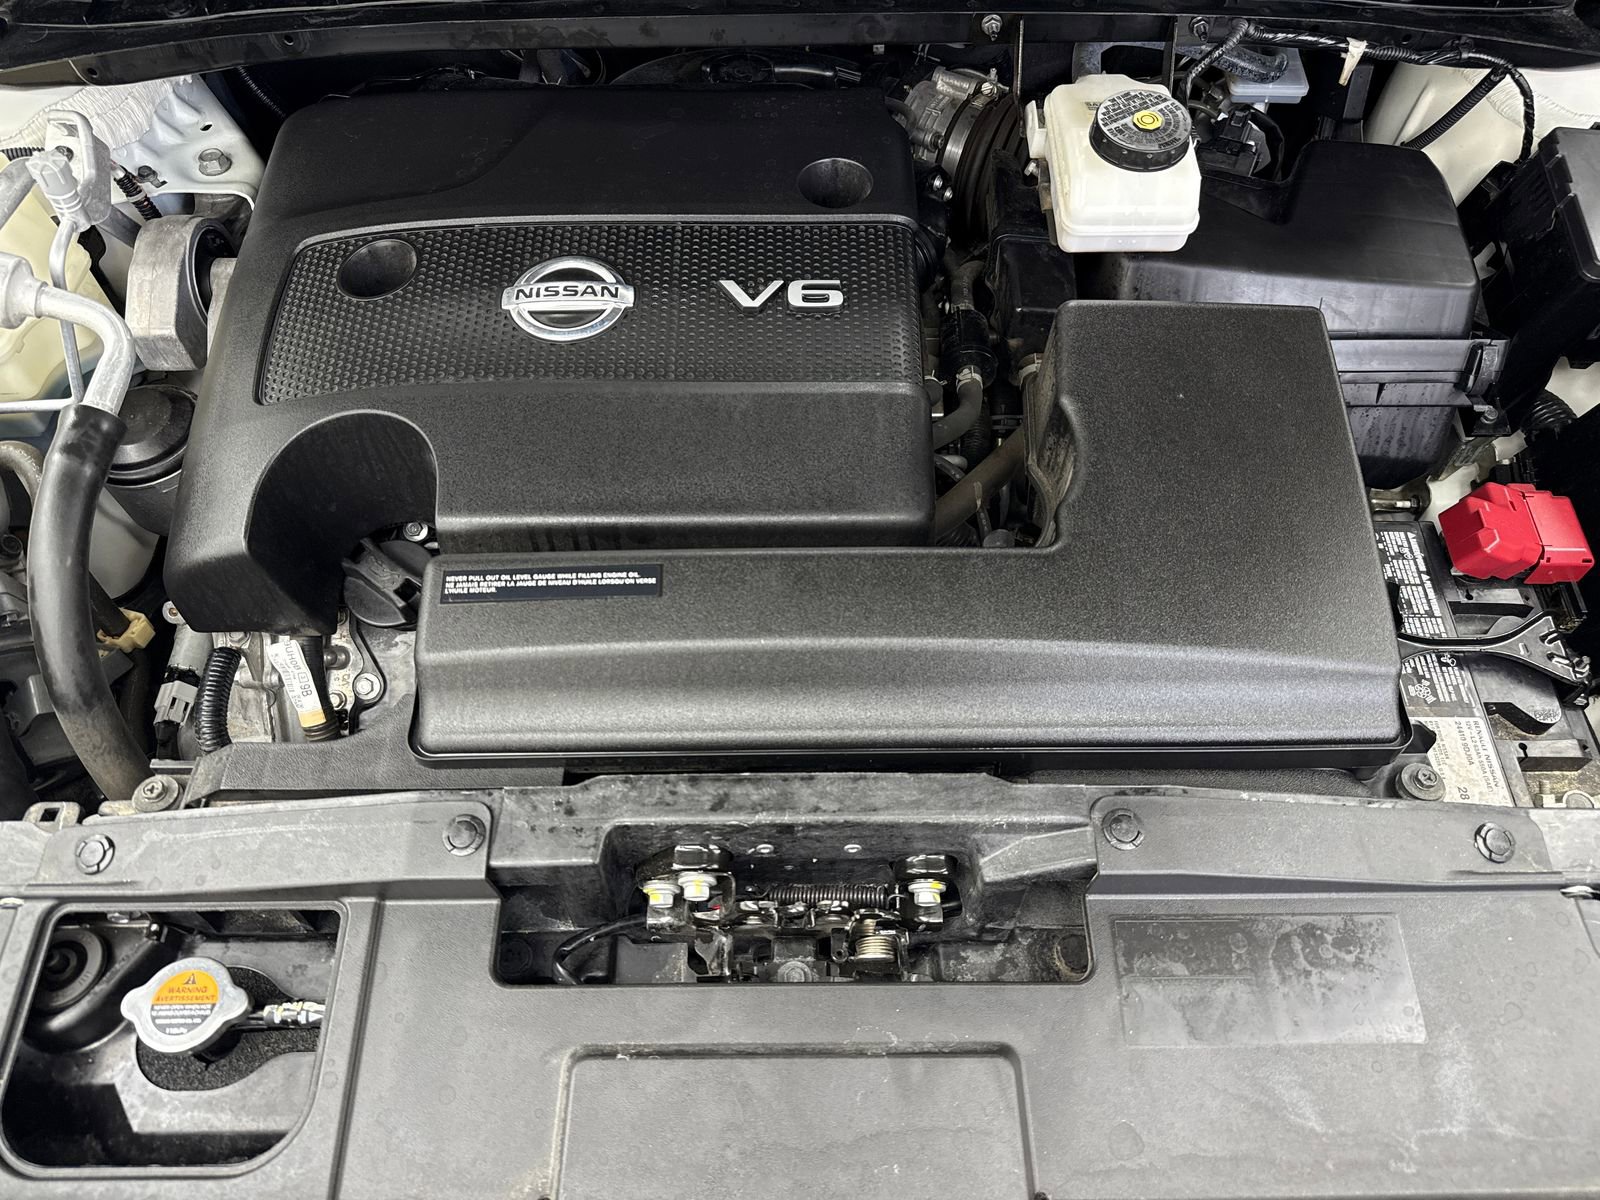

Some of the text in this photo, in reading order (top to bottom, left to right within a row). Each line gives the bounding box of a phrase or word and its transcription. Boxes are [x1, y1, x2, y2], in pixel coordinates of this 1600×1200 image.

[514, 283, 620, 300] NISSAN
[719, 279, 843, 311] V6
[1454, 721, 1467, 741] 24410
[1473, 721, 1500, 787] RENAULT NISSAN
[1457, 786, 1470, 800] 28
[168, 986, 208, 994] WARNING
